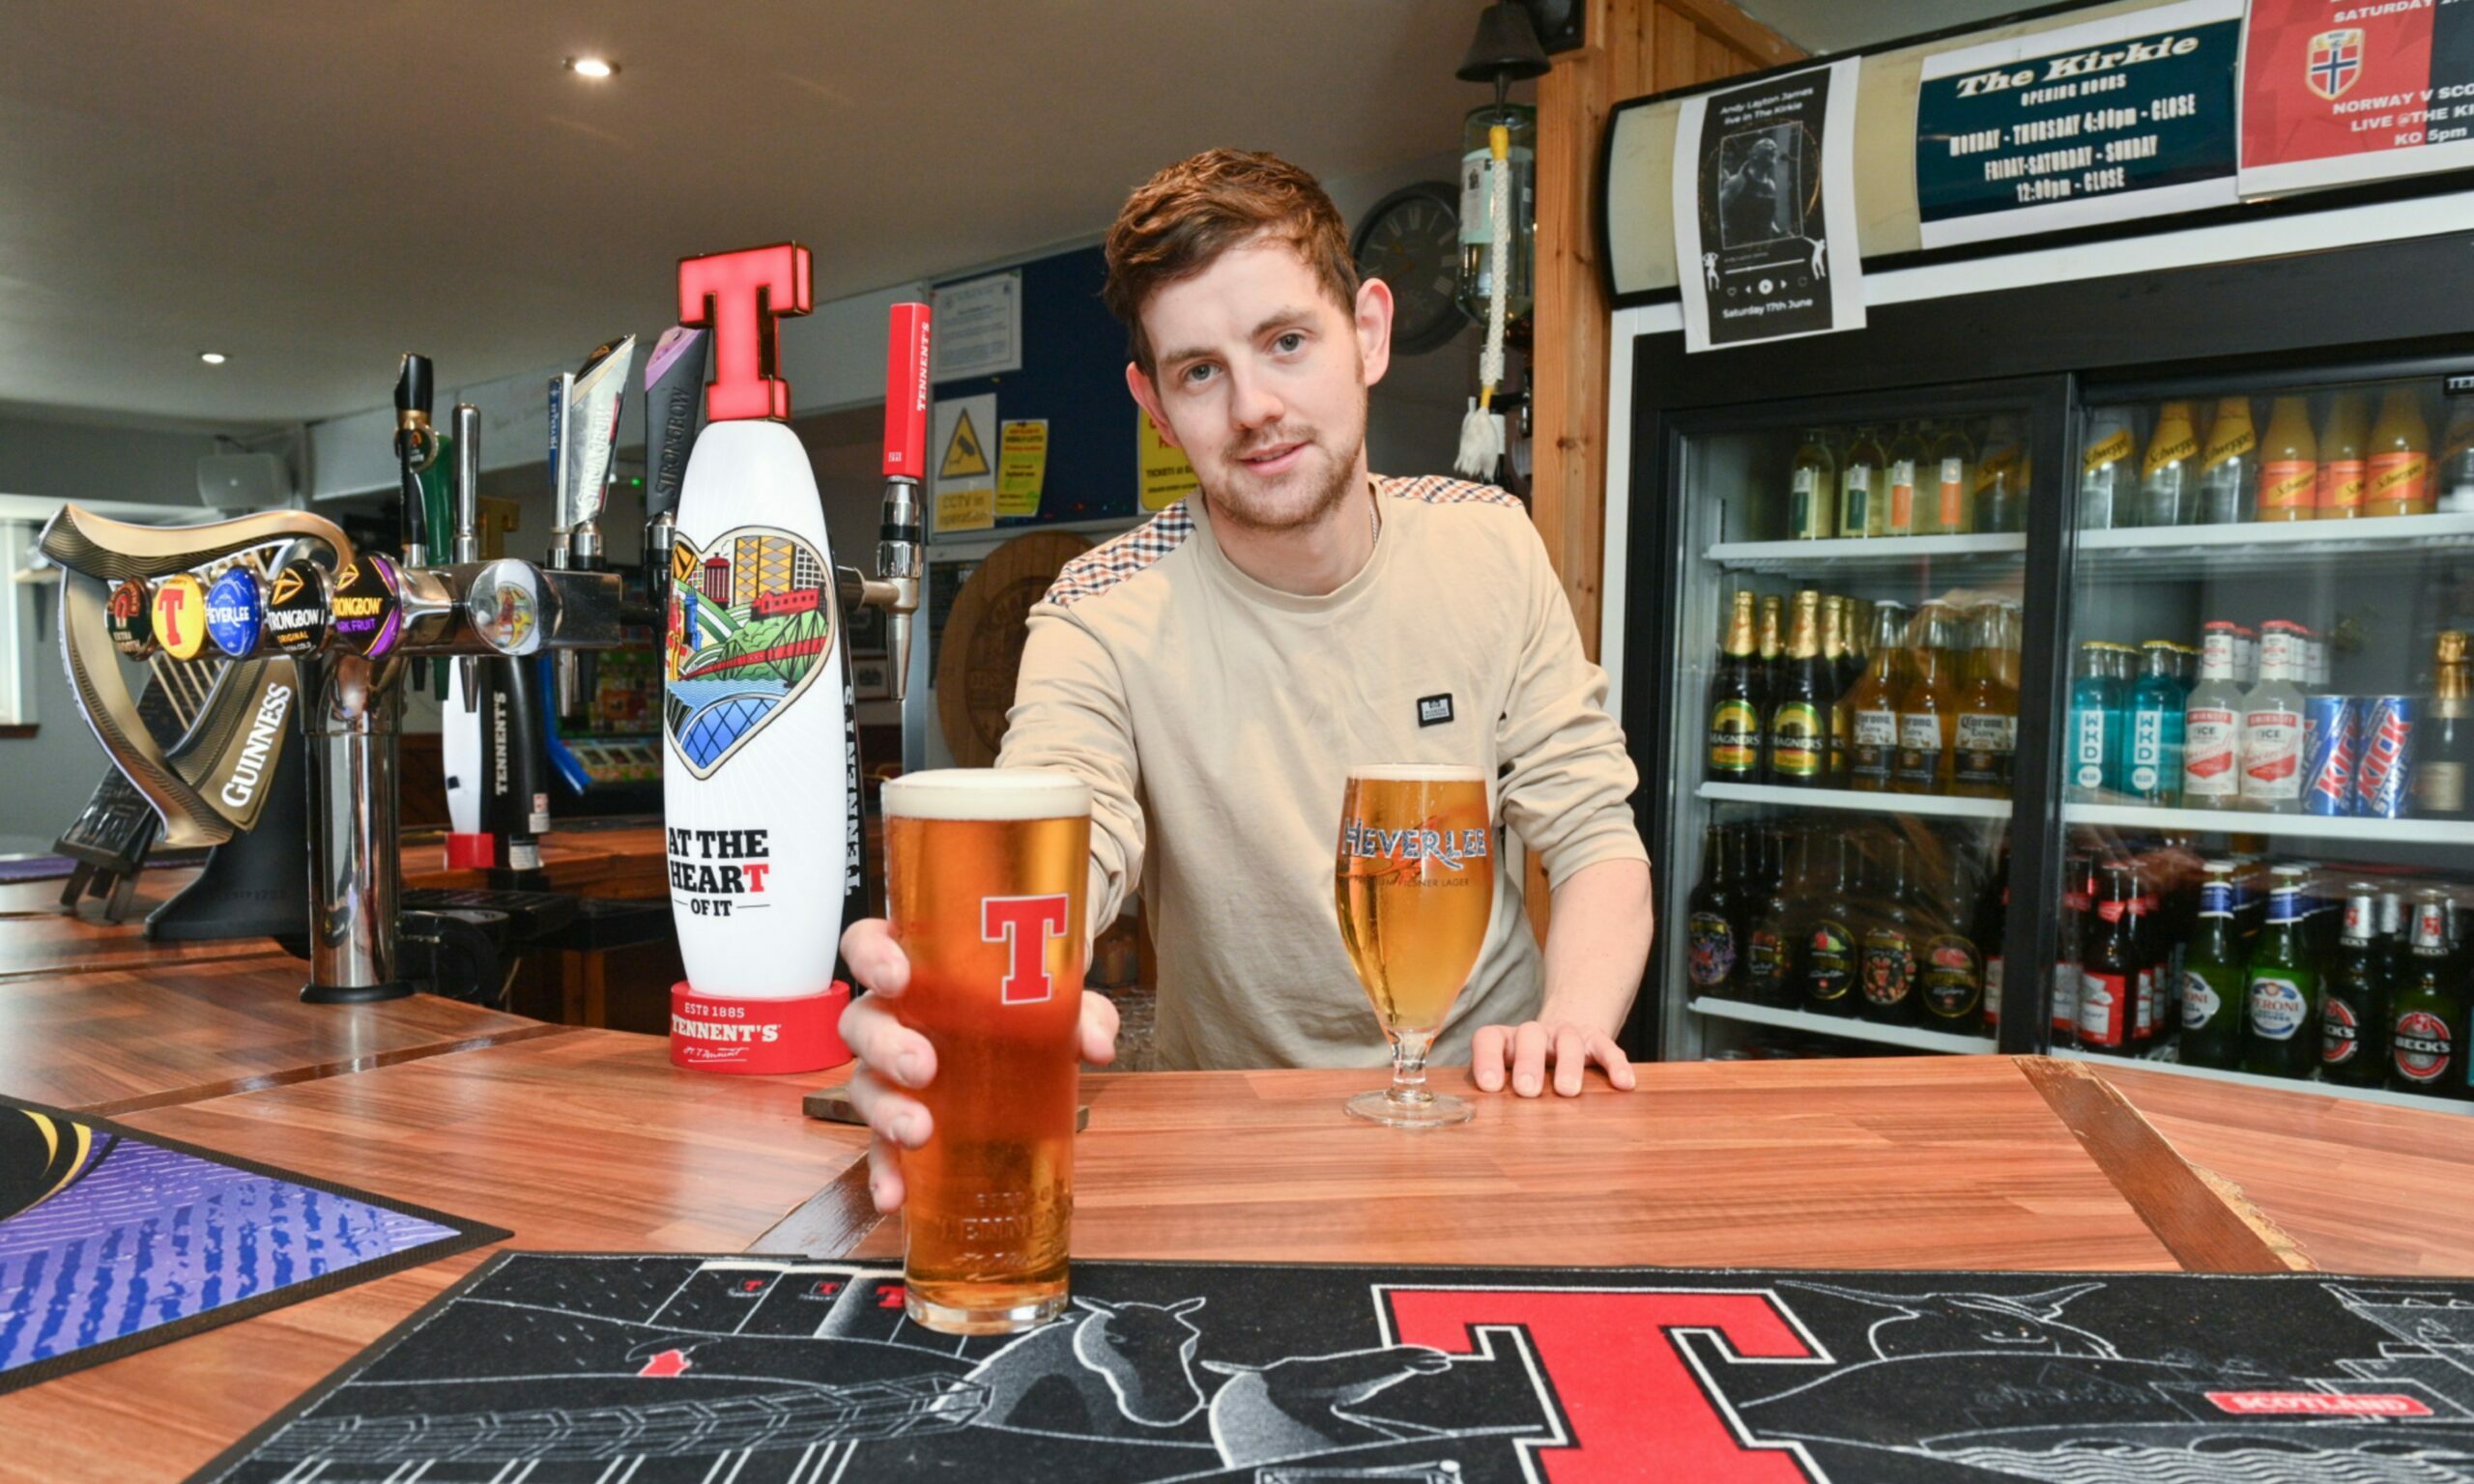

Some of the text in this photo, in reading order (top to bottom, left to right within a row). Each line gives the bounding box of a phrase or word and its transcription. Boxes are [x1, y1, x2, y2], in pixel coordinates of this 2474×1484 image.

[2334, 0, 2432, 23] SATURDAY
[1956, 36, 2200, 98] The Kirkie
[1720, 87, 1814, 116] Andy Layton James
[2021, 73, 2127, 106] OPENING HOURS
[2333, 93, 2414, 115] NORWAY
[2420, 90, 2433, 102] V
[1724, 101, 1802, 126] live in The Kirkie
[1949, 128, 2000, 157] MONDAY
[2013, 115, 2081, 146] THURSDAY
[2084, 107, 2137, 133] 4:00pm
[2151, 94, 2196, 122] CLOSE
[2350, 116, 2393, 132] LIVE
[2398, 107, 2449, 128] @THE
[2105, 134, 2158, 163] SUNDAY
[2394, 127, 2467, 146] KO 5pm
[2017, 178, 2071, 203] 12:00pm
[2084, 167, 2125, 192] CLOSE
[1722, 297, 1813, 319] Saturday 17th June
[678, 243, 813, 421] T
[917, 322, 930, 412] TENNENT'S
[655, 386, 691, 499] STRONGBOW
[221, 682, 292, 809] GUINNESS
[494, 691, 507, 796] TENNENT'S
[2085, 715, 2099, 758] WKD
[2139, 716, 2154, 759] WKD
[2197, 726, 2215, 735] ICE
[2261, 728, 2280, 738] ICE
[2357, 709, 2412, 802] KICK
[669, 827, 769, 859] AT THE
[1341, 817, 1487, 870] HEVERLEE
[670, 860, 769, 894] HEART
[691, 899, 733, 917] OF IT
[982, 893, 1069, 1005] T
[712, 1005, 745, 1019] 1885
[672, 1014, 780, 1043] TENNENT'S
[2395, 1035, 2451, 1052] BECK'S
[2232, 1396, 2407, 1412] SCOTLAND
